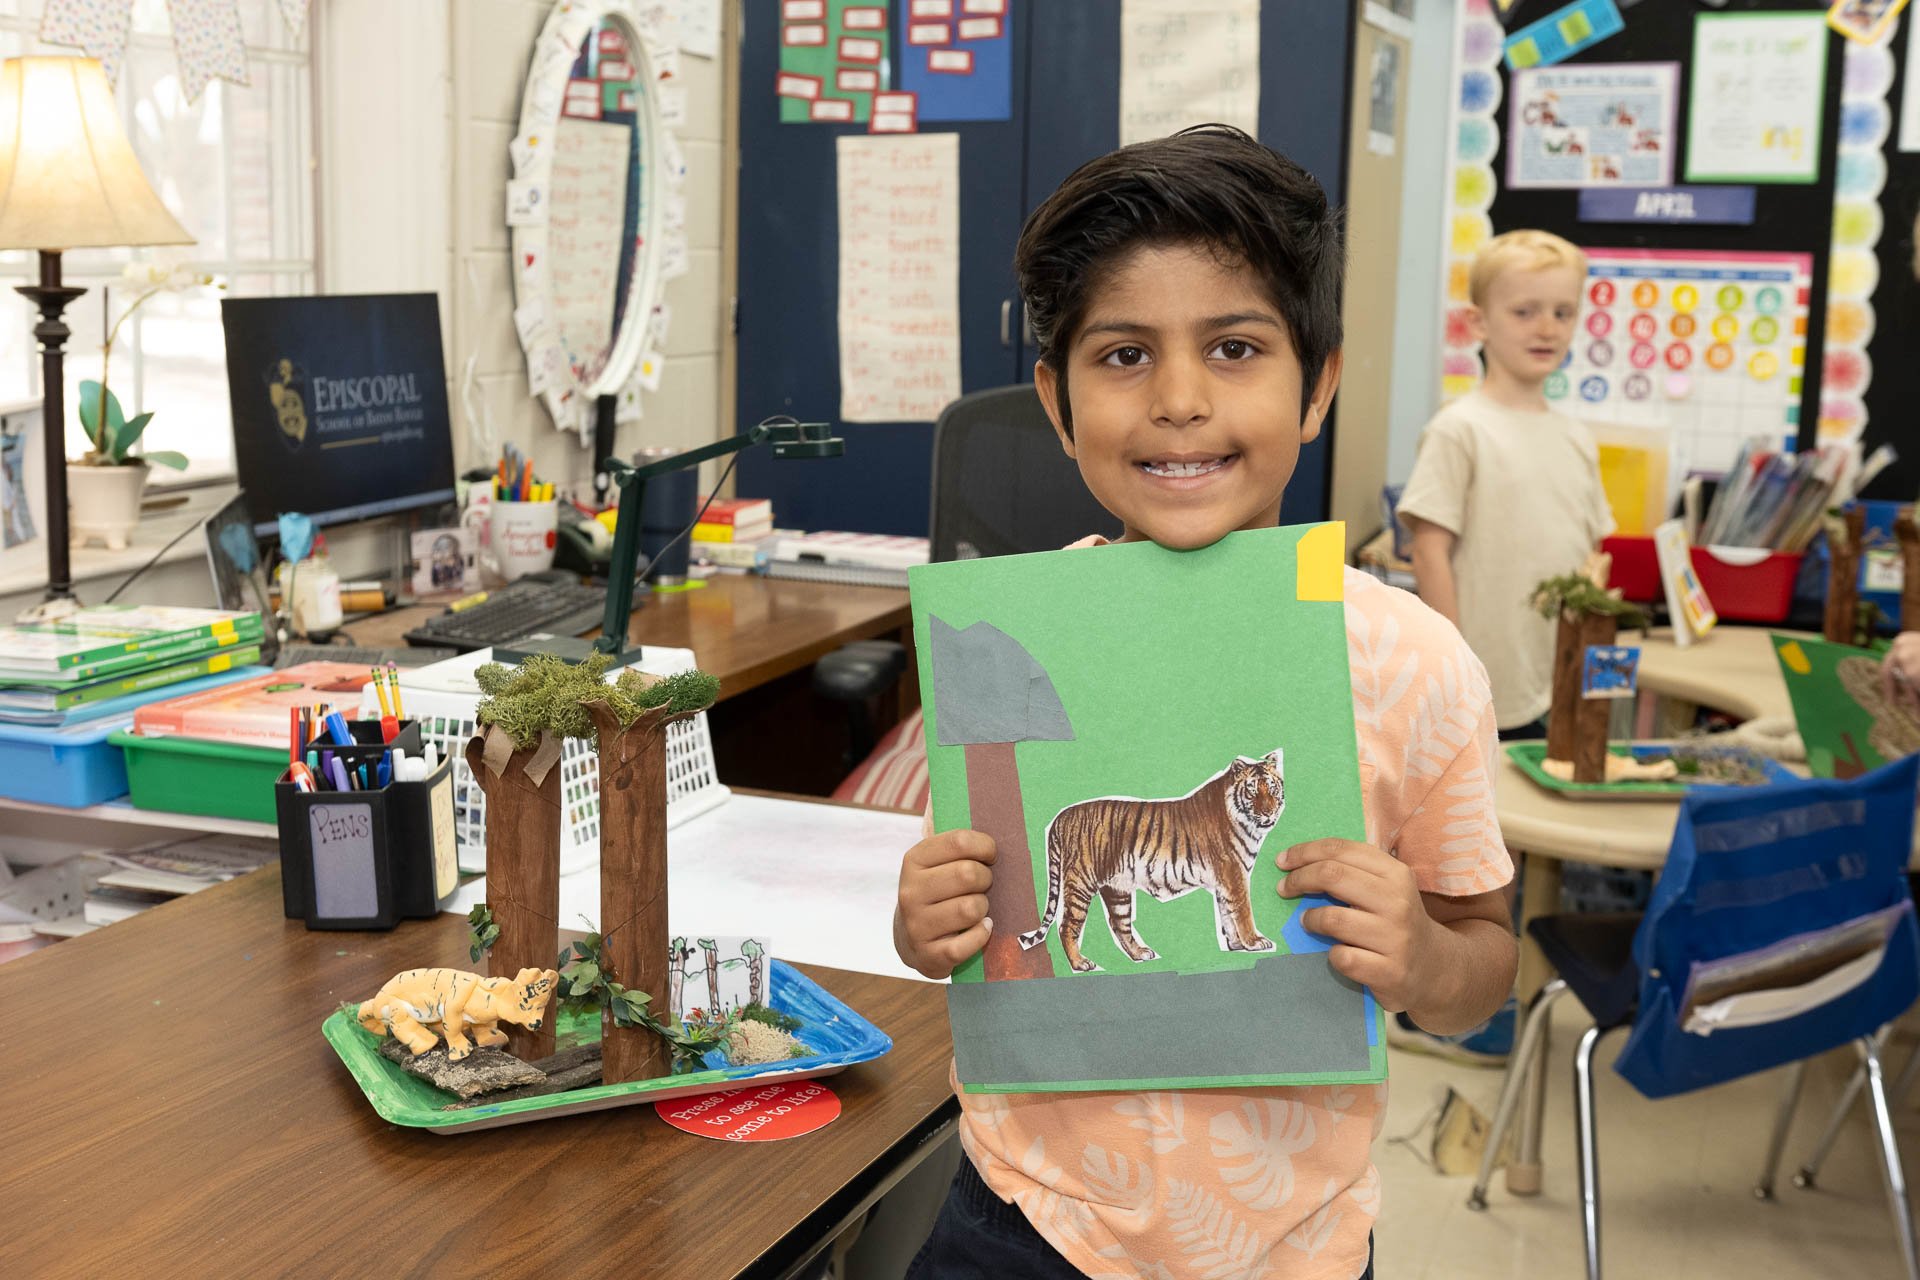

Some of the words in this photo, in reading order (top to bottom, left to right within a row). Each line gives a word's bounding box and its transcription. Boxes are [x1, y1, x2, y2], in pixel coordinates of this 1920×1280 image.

[1634, 192, 1696, 218] APRIL
[313, 373, 422, 412] EPISCOPAL
[311, 806, 369, 844] PENS
[670, 1095, 725, 1121] Press
[705, 1115, 732, 1126] to
[729, 1100, 760, 1116] see
[754, 1085, 786, 1102] me
[725, 1115, 773, 1141] come
[765, 1105, 792, 1117] to
[783, 1085, 828, 1107] life!
